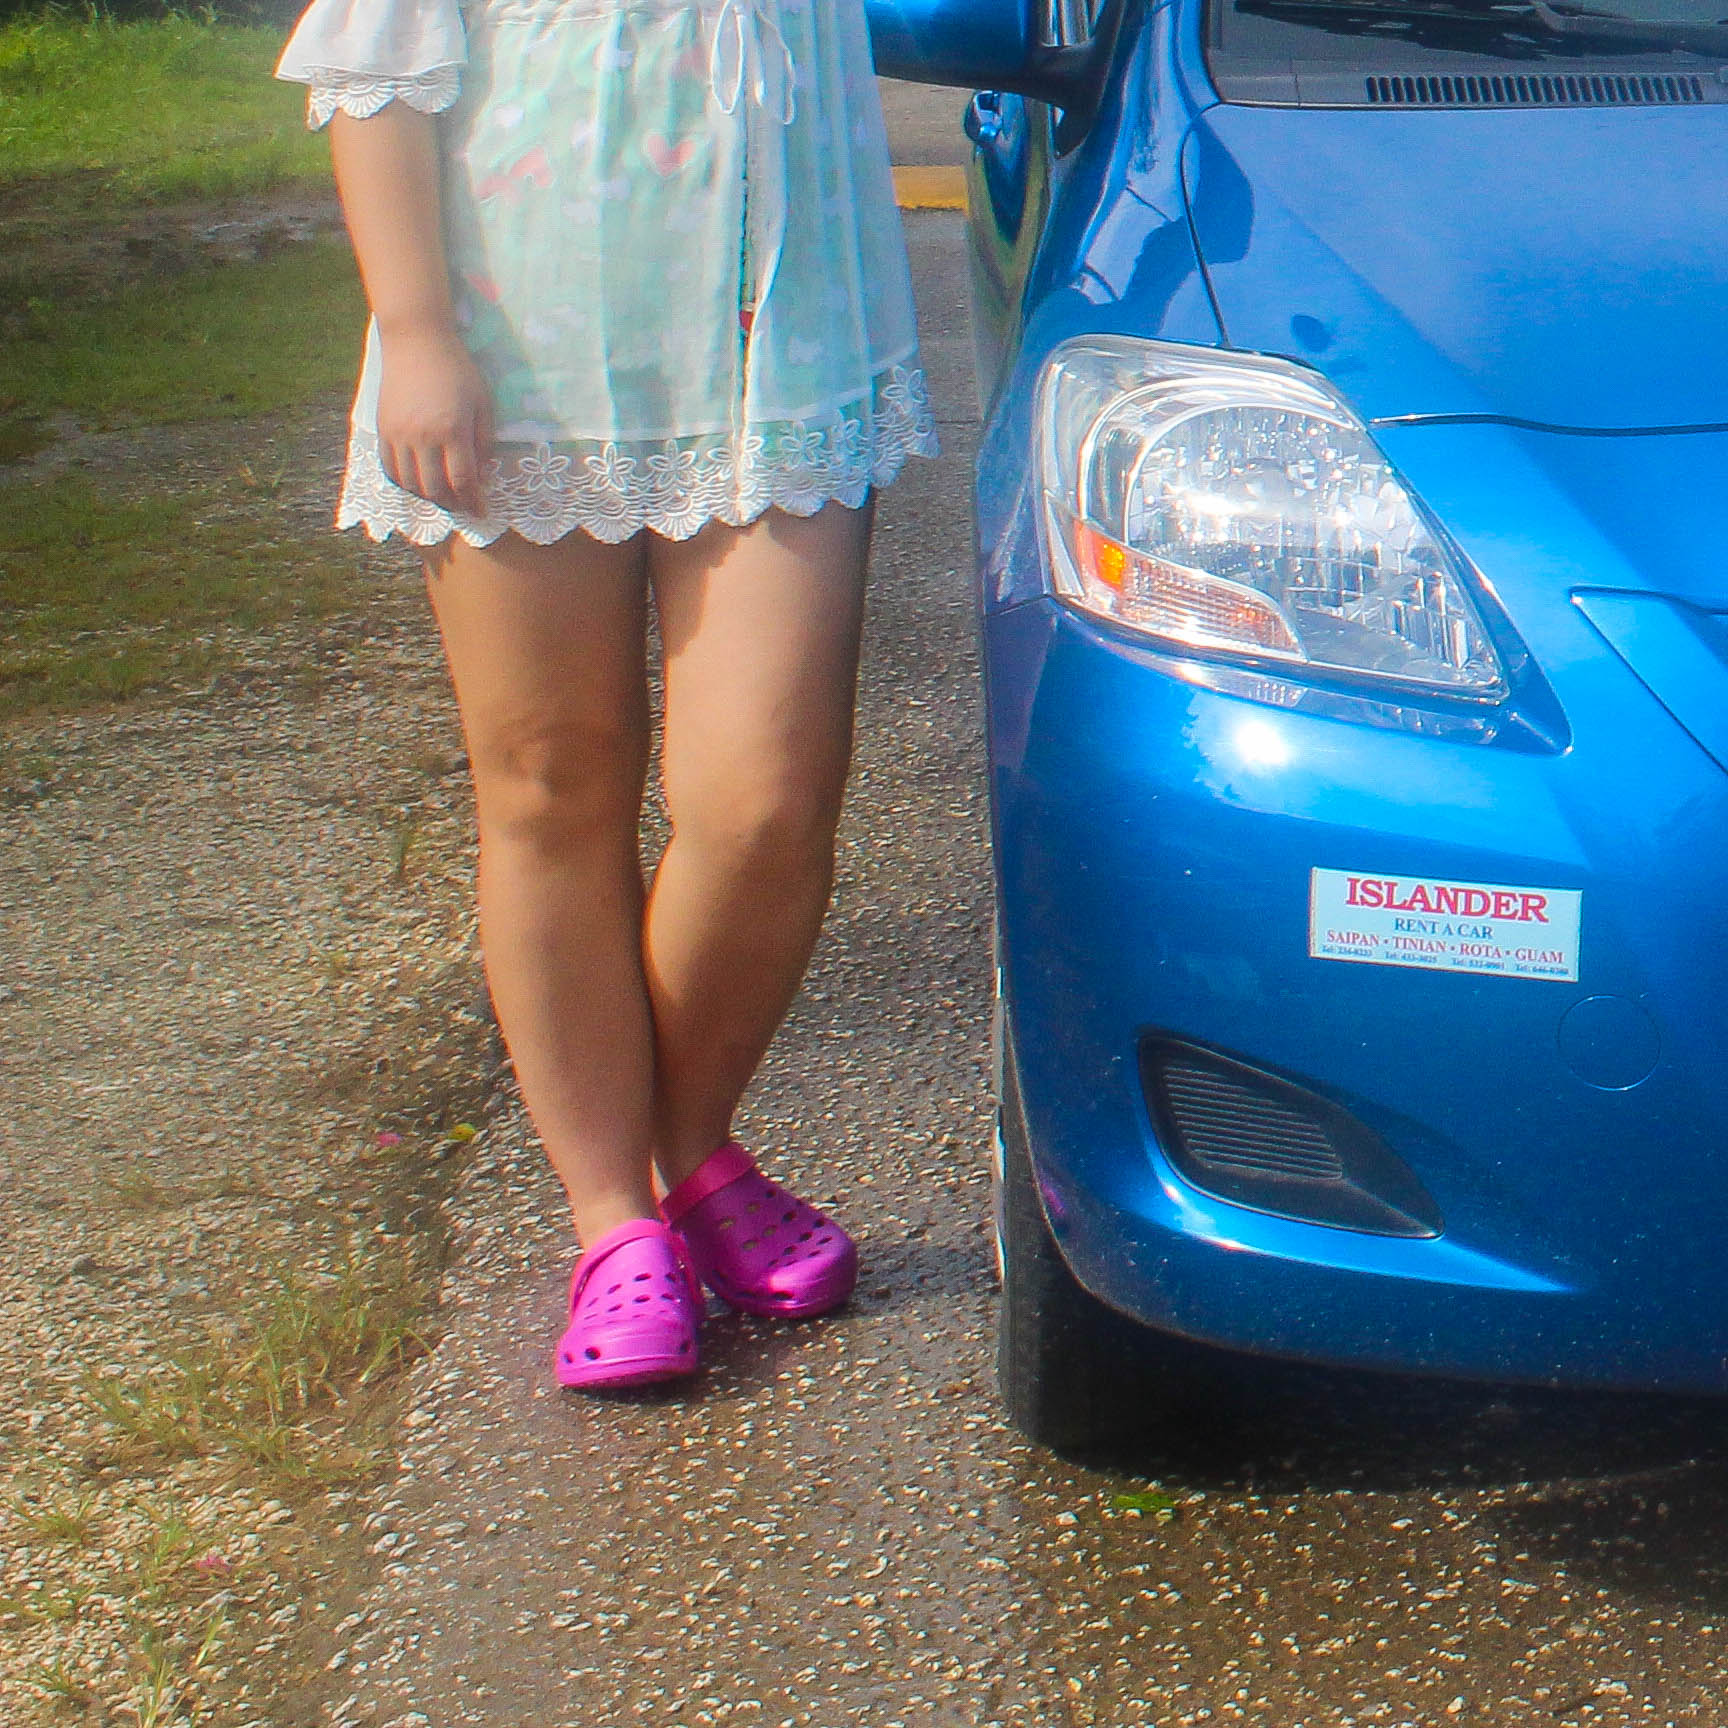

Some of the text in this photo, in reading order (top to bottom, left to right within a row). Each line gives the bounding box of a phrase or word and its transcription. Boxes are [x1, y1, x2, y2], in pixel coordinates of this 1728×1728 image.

[1345, 876, 1549, 923] ISLANDER
[1326, 928, 1564, 964] SAIPAN TINIAN ROTA GUAM
[1394, 917, 1493, 940] RENT A CAR
